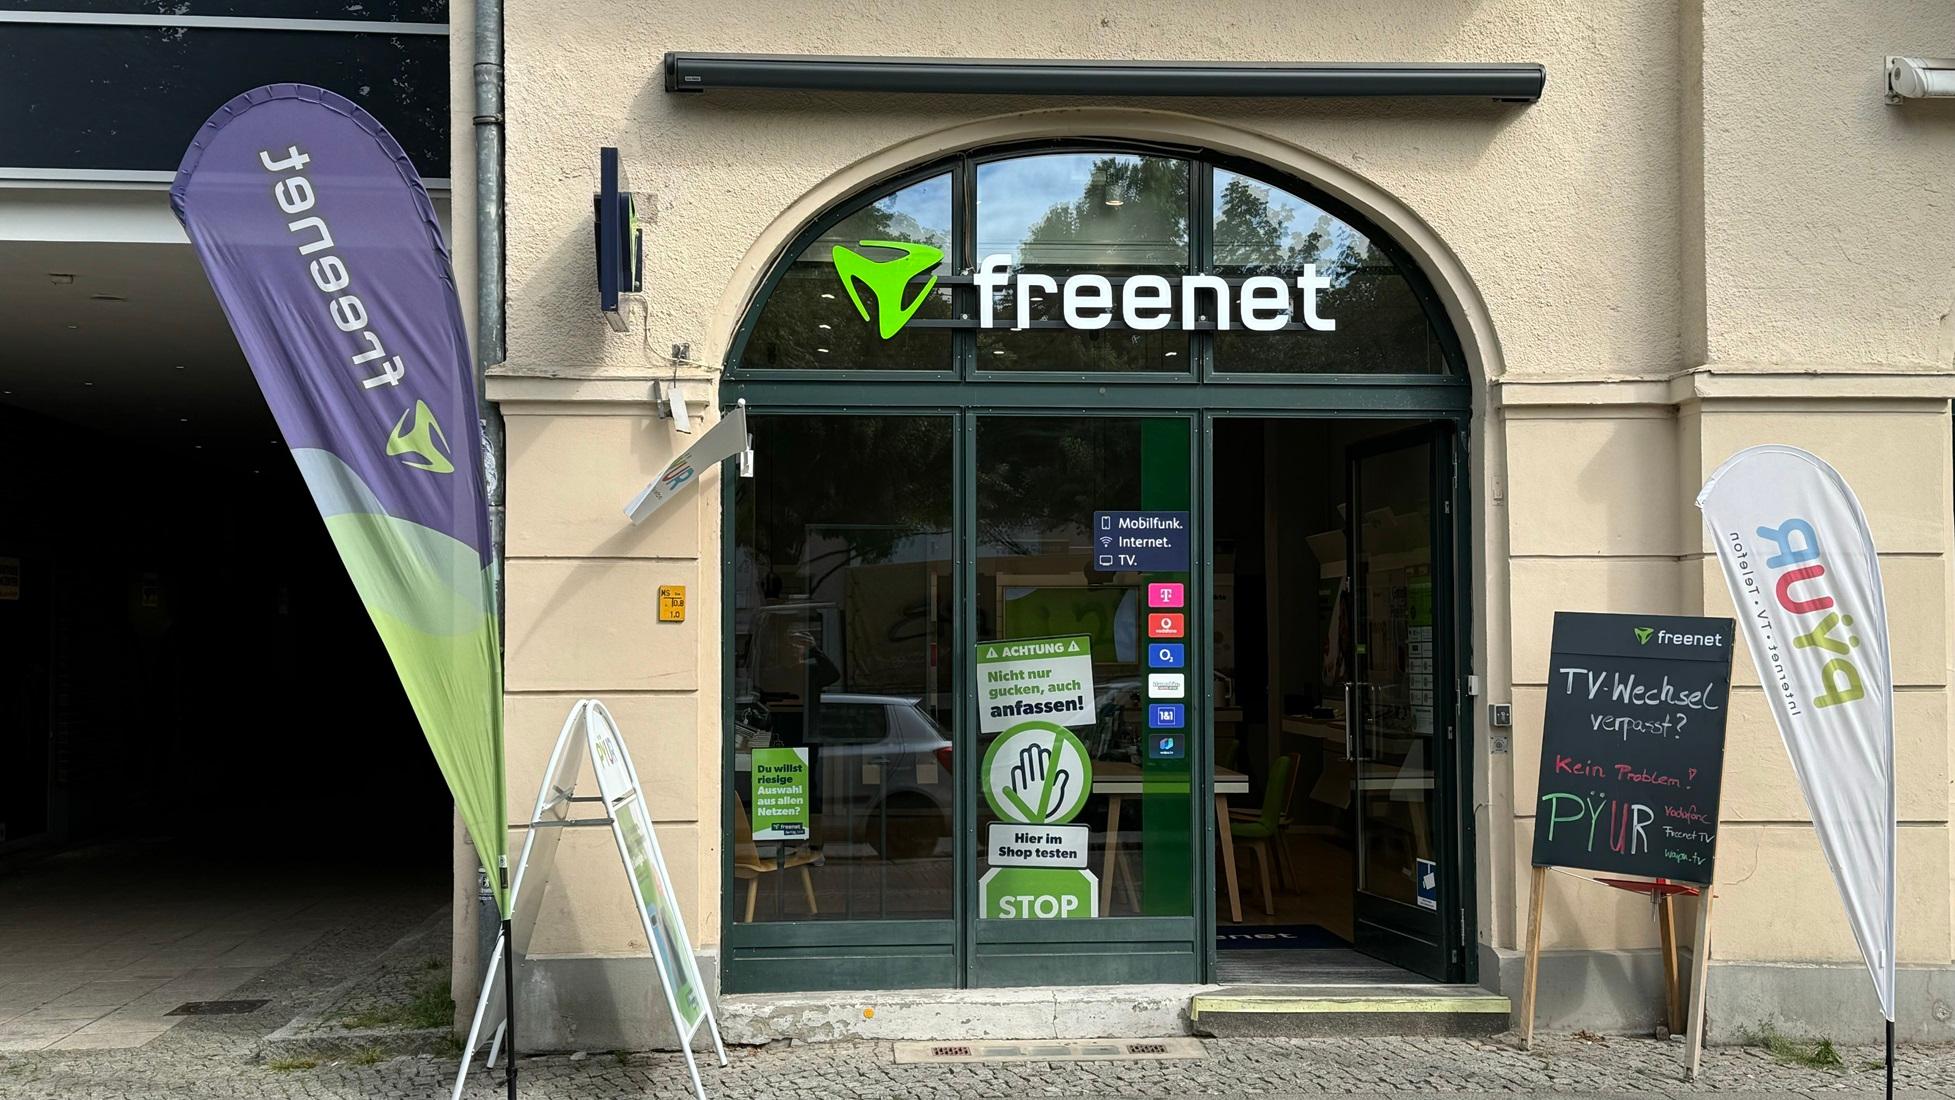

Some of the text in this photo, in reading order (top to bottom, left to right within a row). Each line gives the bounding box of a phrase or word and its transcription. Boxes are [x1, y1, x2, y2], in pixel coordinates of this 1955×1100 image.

[973, 253, 1336, 332] freenet
[1118, 517, 1184, 529] Mobilfunk.
[1119, 536, 1172, 548] Internet.
[1118, 554, 1138, 566] TV.
[1658, 630, 1722, 647] freenet
[1002, 642, 1065, 658] ACHTUNG
[987, 668, 1052, 683] Nicht nur
[988, 680, 1082, 700] gucken, auch
[1559, 667, 1719, 710] TV-Wechsel
[990, 695, 1085, 718] anfassen!
[1159, 711, 1174, 721] 1&1
[1590, 713, 1688, 741] verpasst?
[757, 764, 803, 773] Du willst
[1556, 754, 1606, 777] Kein
[757, 775, 793, 785] riesige
[757, 785, 803, 795] Auswahl
[757, 796, 804, 806] aus allen
[757, 806, 801, 817] Netzen?
[1542, 790, 1655, 855] PŸUR
[1014, 832, 1063, 845] Hier im
[998, 846, 1078, 860] Shop testen
[998, 894, 1079, 919] STOP
